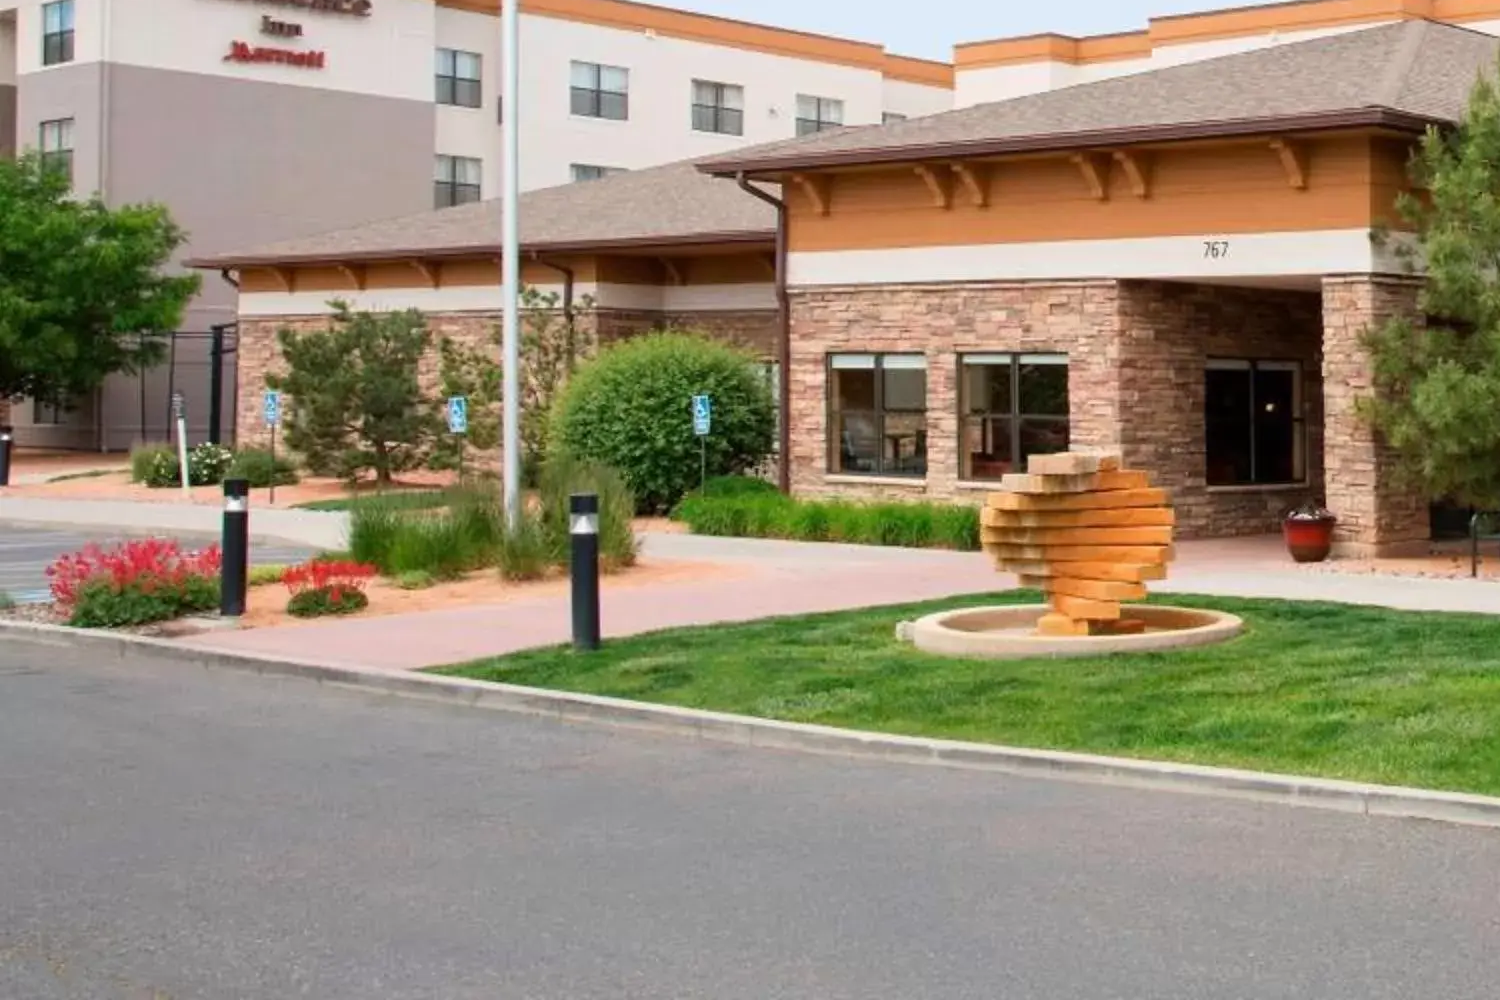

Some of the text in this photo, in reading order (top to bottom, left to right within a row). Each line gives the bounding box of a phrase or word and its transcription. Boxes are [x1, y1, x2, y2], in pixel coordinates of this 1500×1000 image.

[260, 15, 303, 37] Inn
[222, 39, 325, 69] Marriott
[1203, 241, 1229, 258] 767
